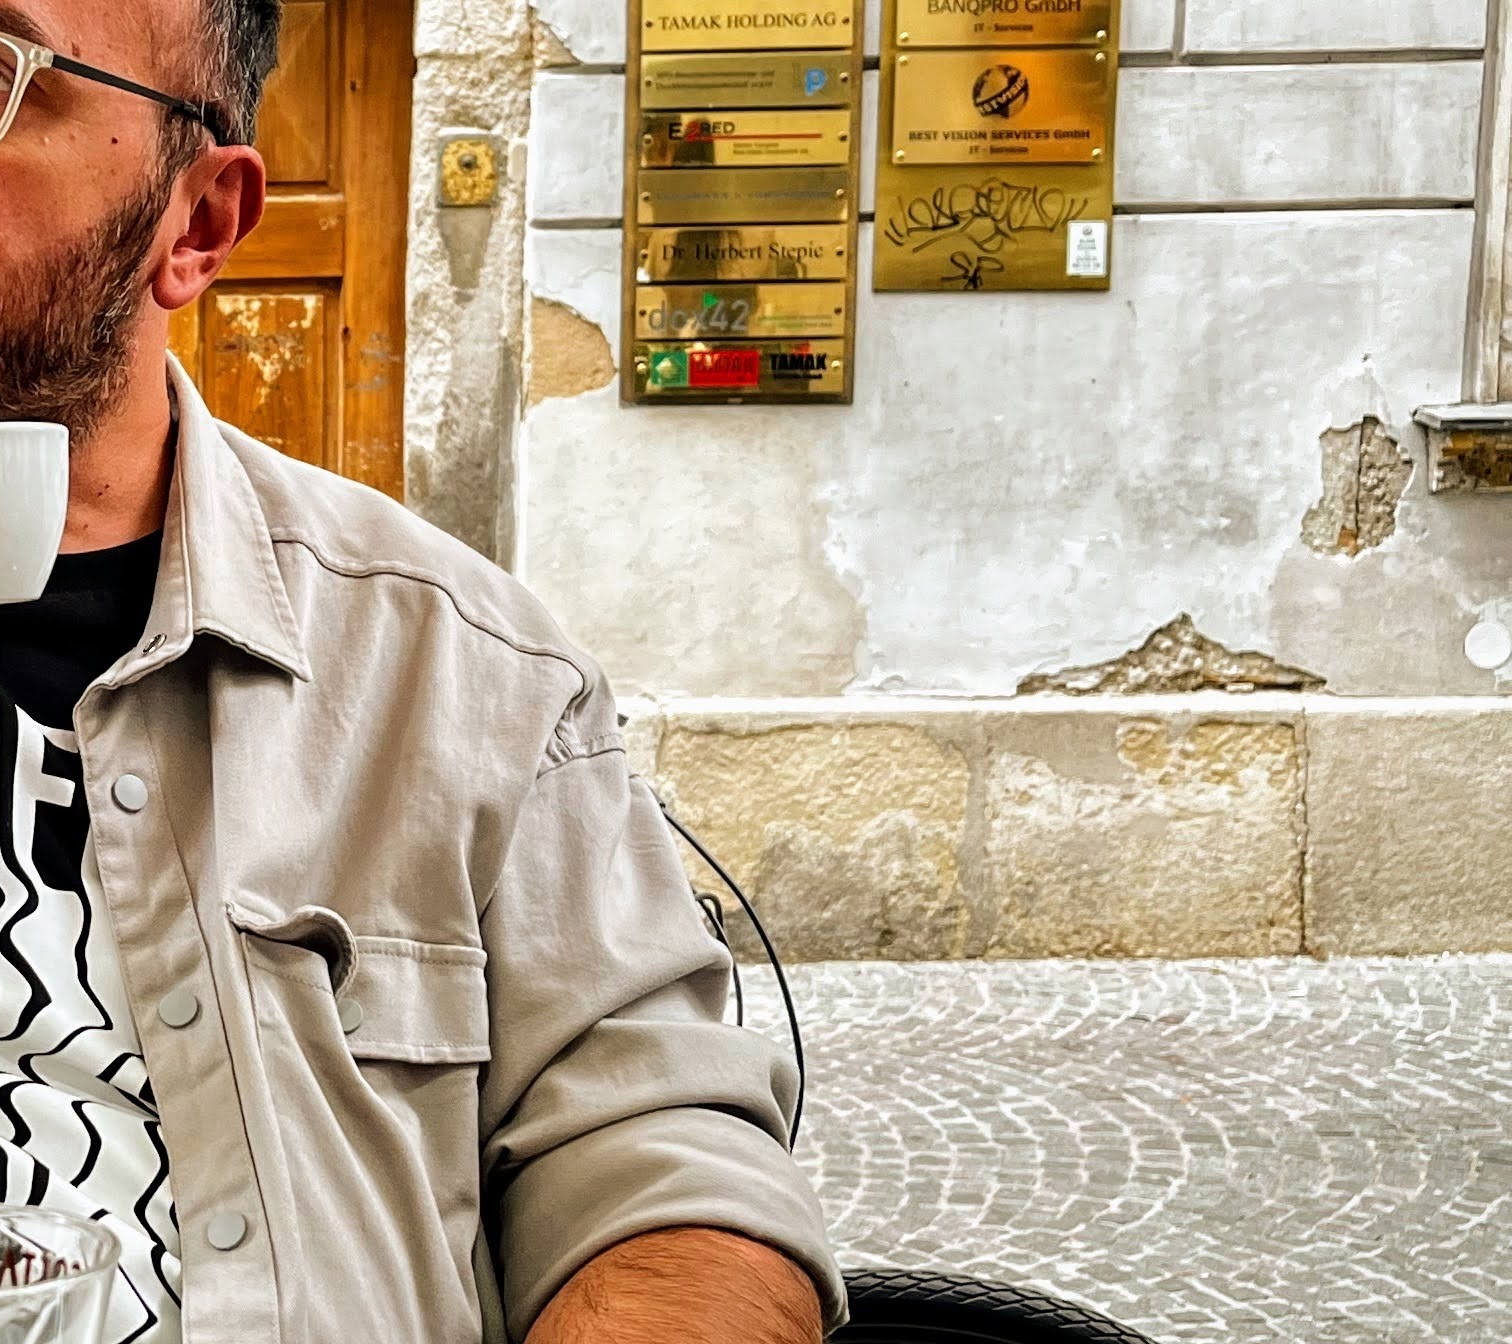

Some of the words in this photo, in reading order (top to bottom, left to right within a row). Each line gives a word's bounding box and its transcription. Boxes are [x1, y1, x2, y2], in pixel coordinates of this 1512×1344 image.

[658, 14, 721, 31] TAMAK
[726, 12, 808, 29] HOLDING
[811, 11, 837, 26] AG
[908, 130, 938, 141] BEST
[942, 130, 987, 141] VISION
[990, 130, 1050, 140] SERVICES
[694, 242, 762, 261] Herbert
[648, 299, 750, 332] dox42
[770, 353, 827, 370] TAMAK
